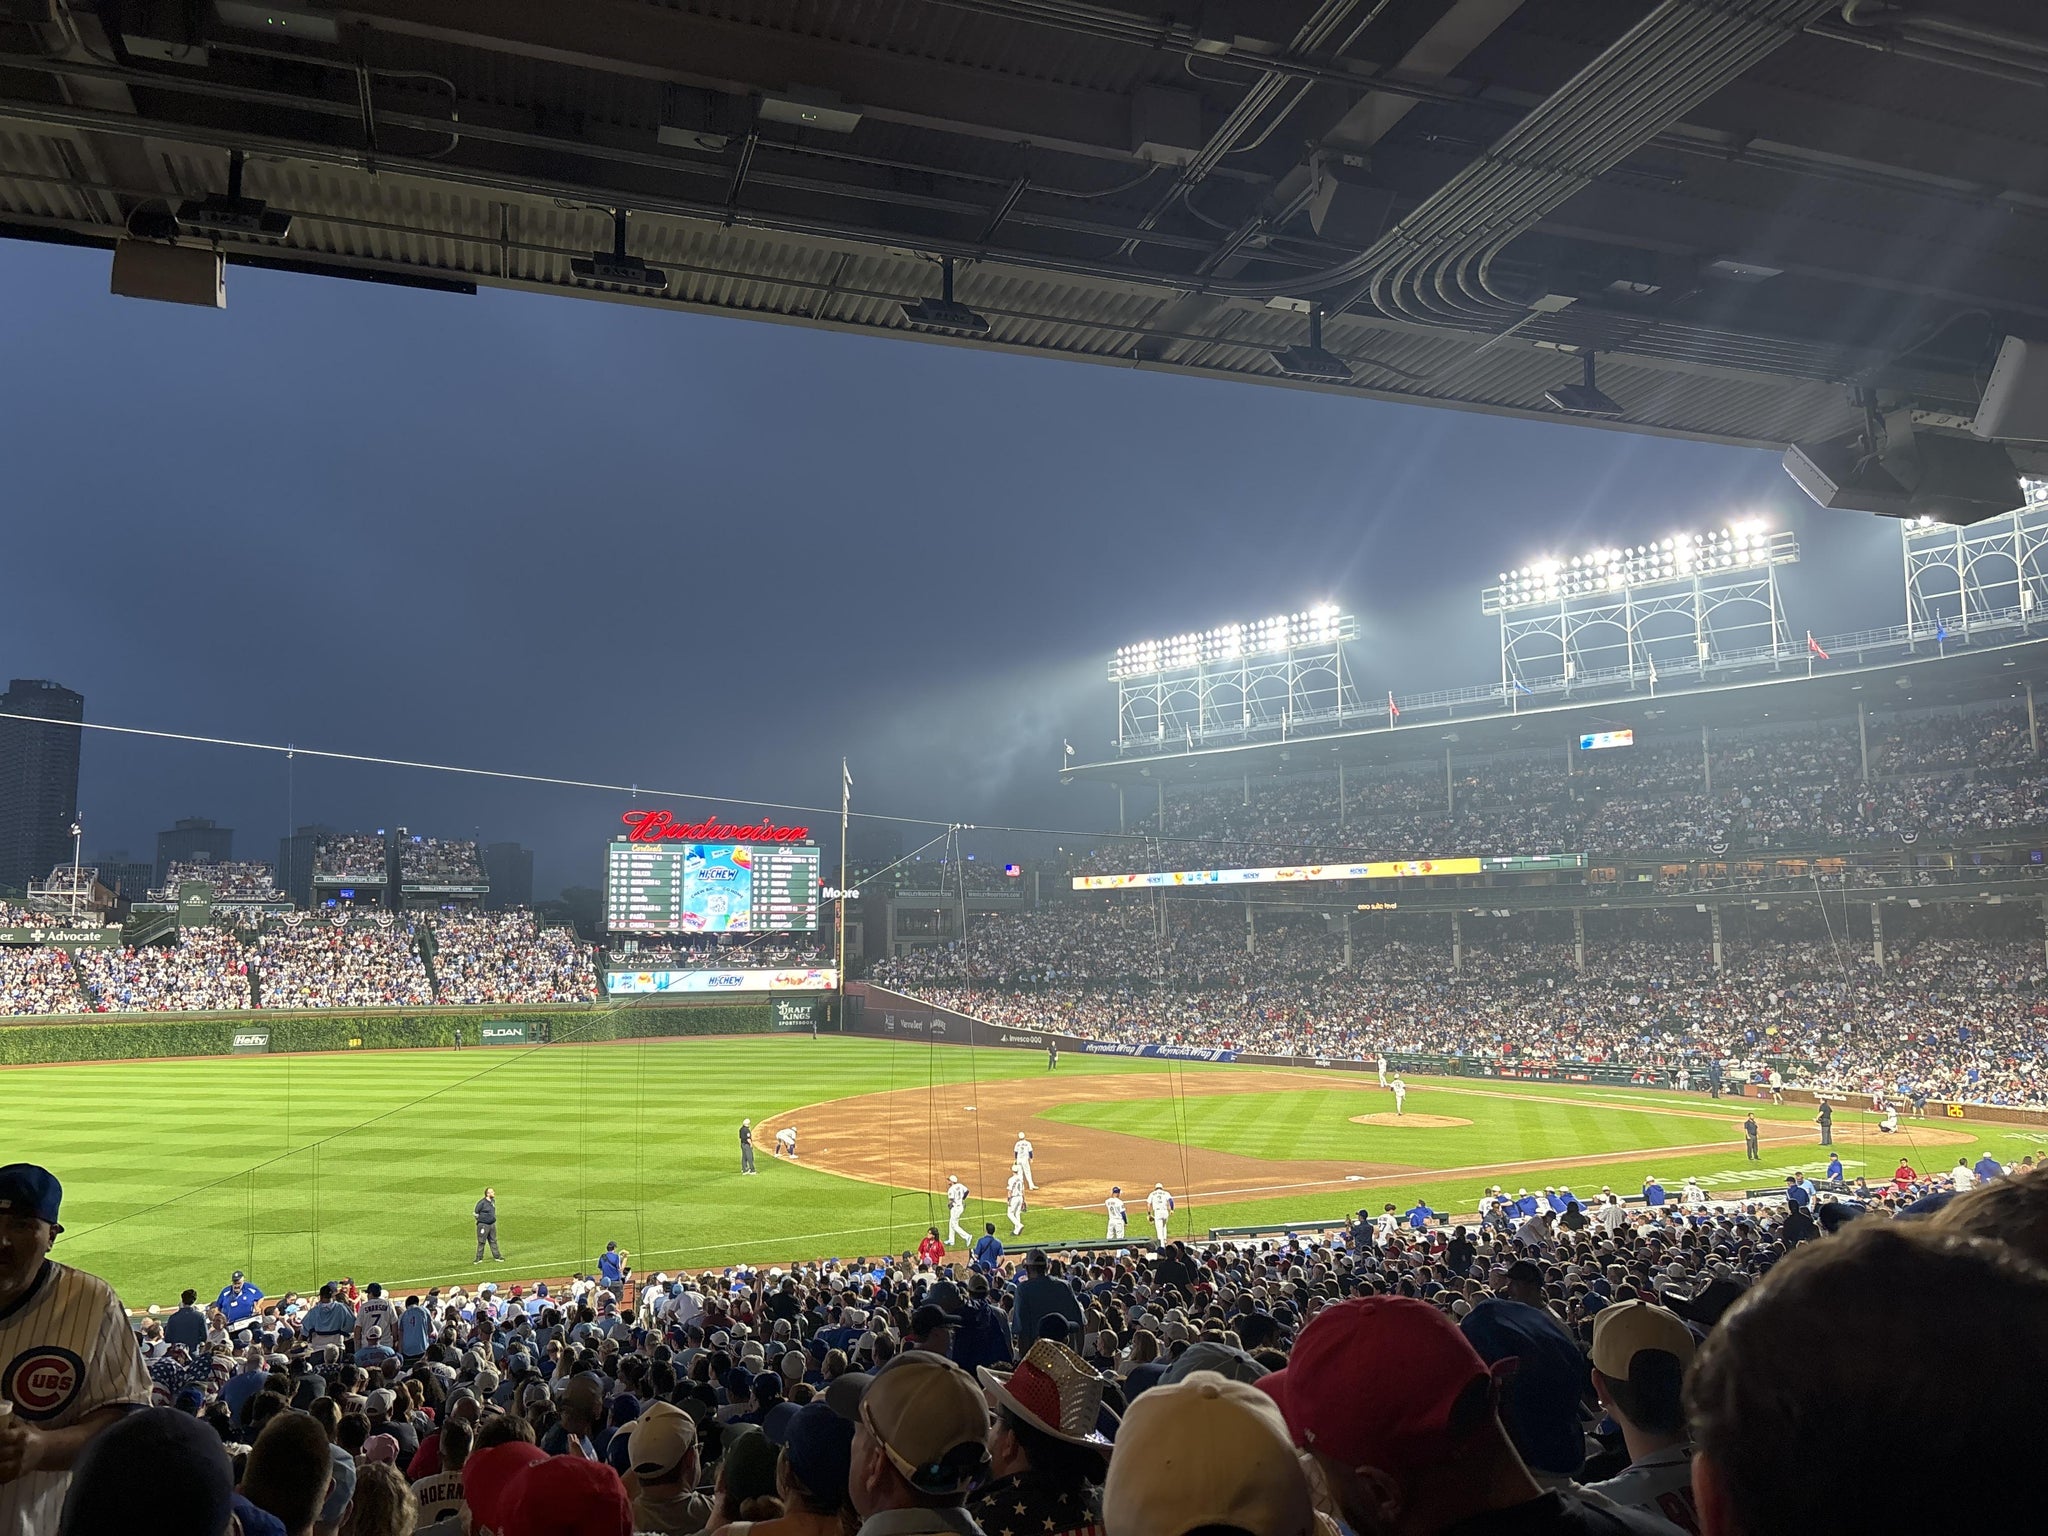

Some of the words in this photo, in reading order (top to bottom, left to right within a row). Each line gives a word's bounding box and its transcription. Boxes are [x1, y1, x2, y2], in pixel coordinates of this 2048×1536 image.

[622, 810, 809, 842] Budweiser
[822, 887, 860, 899] Moore
[46, 931, 101, 941] Advocate
[779, 1006, 812, 1016] DRAFT
[782, 1013, 811, 1021] KINGS
[482, 1028, 522, 1037] SLOAN
[235, 1035, 266, 1046] Hefty
[1009, 1034, 1030, 1043] Invesco
[1085, 1043, 1116, 1054] Reynolds
[1115, 1044, 1136, 1054] Wrap
[1156, 1045, 1191, 1057] Reynolds
[1190, 1047, 1212, 1060] Wrap
[371, 1313, 381, 1327] 7
